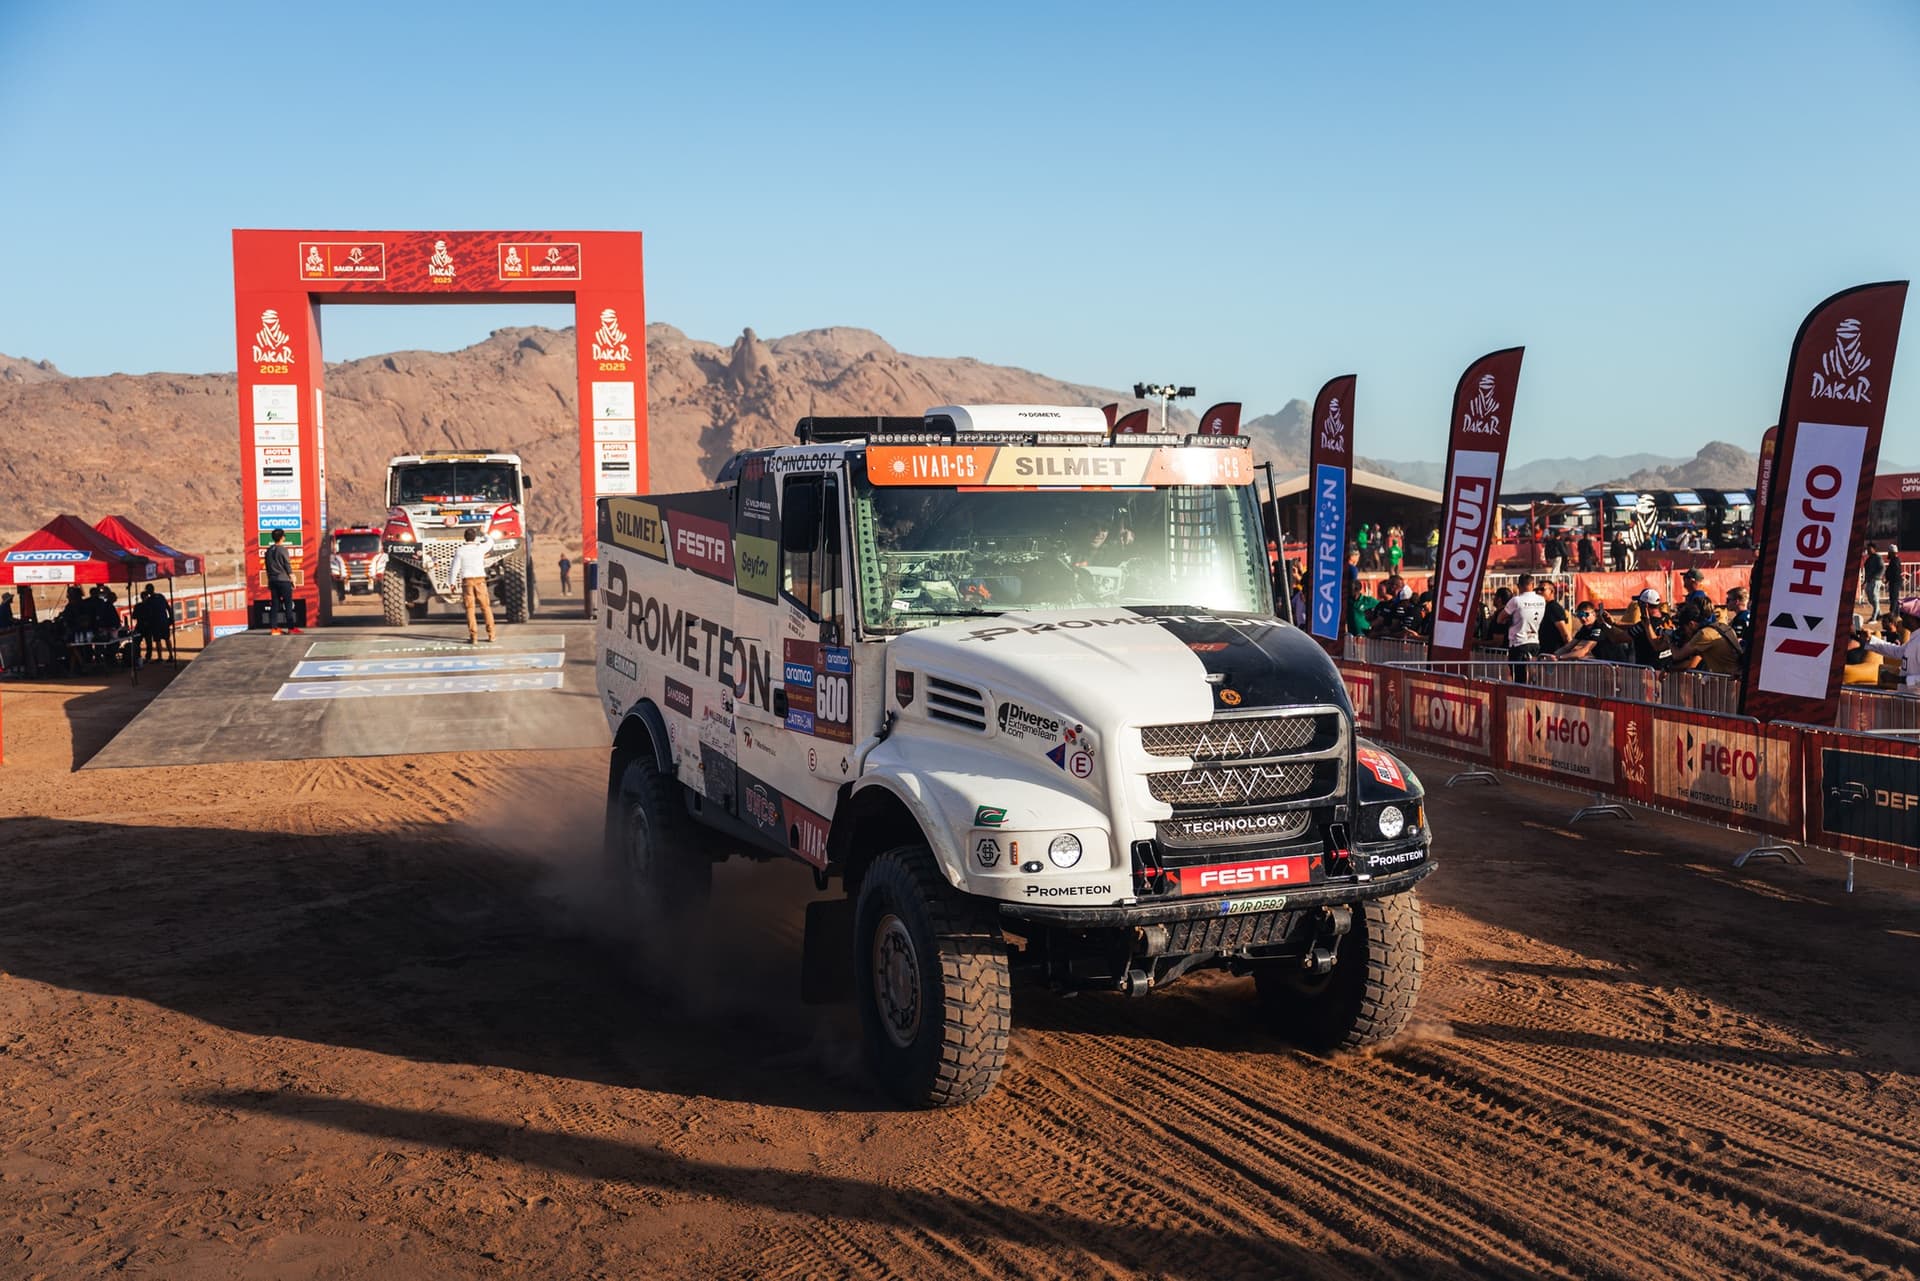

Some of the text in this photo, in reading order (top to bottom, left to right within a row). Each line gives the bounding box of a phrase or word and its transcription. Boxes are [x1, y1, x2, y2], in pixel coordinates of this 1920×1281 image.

[428, 264, 457, 277] DAKAR
[252, 345, 295, 364] DAKAR
[592, 343, 632, 362] DAKAR
[260, 365, 289, 374] 2025
[599, 363, 626, 371] 2025
[1810, 372, 1872, 403] DAKAR
[1463, 414, 1500, 435] DAKAR
[1320, 432, 1345, 453] DAKAR
[763, 452, 836, 473] TECHNOLOGY
[1015, 457, 1127, 476] SILMET
[616, 511, 658, 544] SILMET
[1789, 464, 1843, 597] Hero
[12, 552, 85, 561] aramco
[677, 528, 726, 564] FESTA
[1444, 483, 1485, 616] MOTUL
[600, 560, 771, 713] PROMETEON
[960, 615, 1289, 642] PROMETEON
[316, 656, 543, 672] aramco
[827, 654, 849, 665] aramco
[786, 667, 812, 683] aramco
[667, 686, 690, 708] SANDBERG
[816, 674, 848, 724] 600
[1010, 703, 1059, 732] Diverse
[1413, 694, 1479, 737] MOTUL
[1007, 728, 1024, 740] .com
[1008, 718, 1057, 742] ExtremeTeam
[1546, 715, 1590, 747] Hero
[1076, 757, 1087, 773] E
[1528, 754, 1592, 775] THE MOTORCYCLE LEADER
[1701, 743, 1758, 780] Hero
[1677, 786, 1758, 813] THE MOTORCYCLE LEADER
[1875, 789, 1919, 811] DEF
[1183, 815, 1287, 834] TECHNOLOGY
[1368, 849, 1424, 867] PROMETEON
[1201, 864, 1289, 888] FESTA
[1023, 885, 1111, 898] PROMETEON
